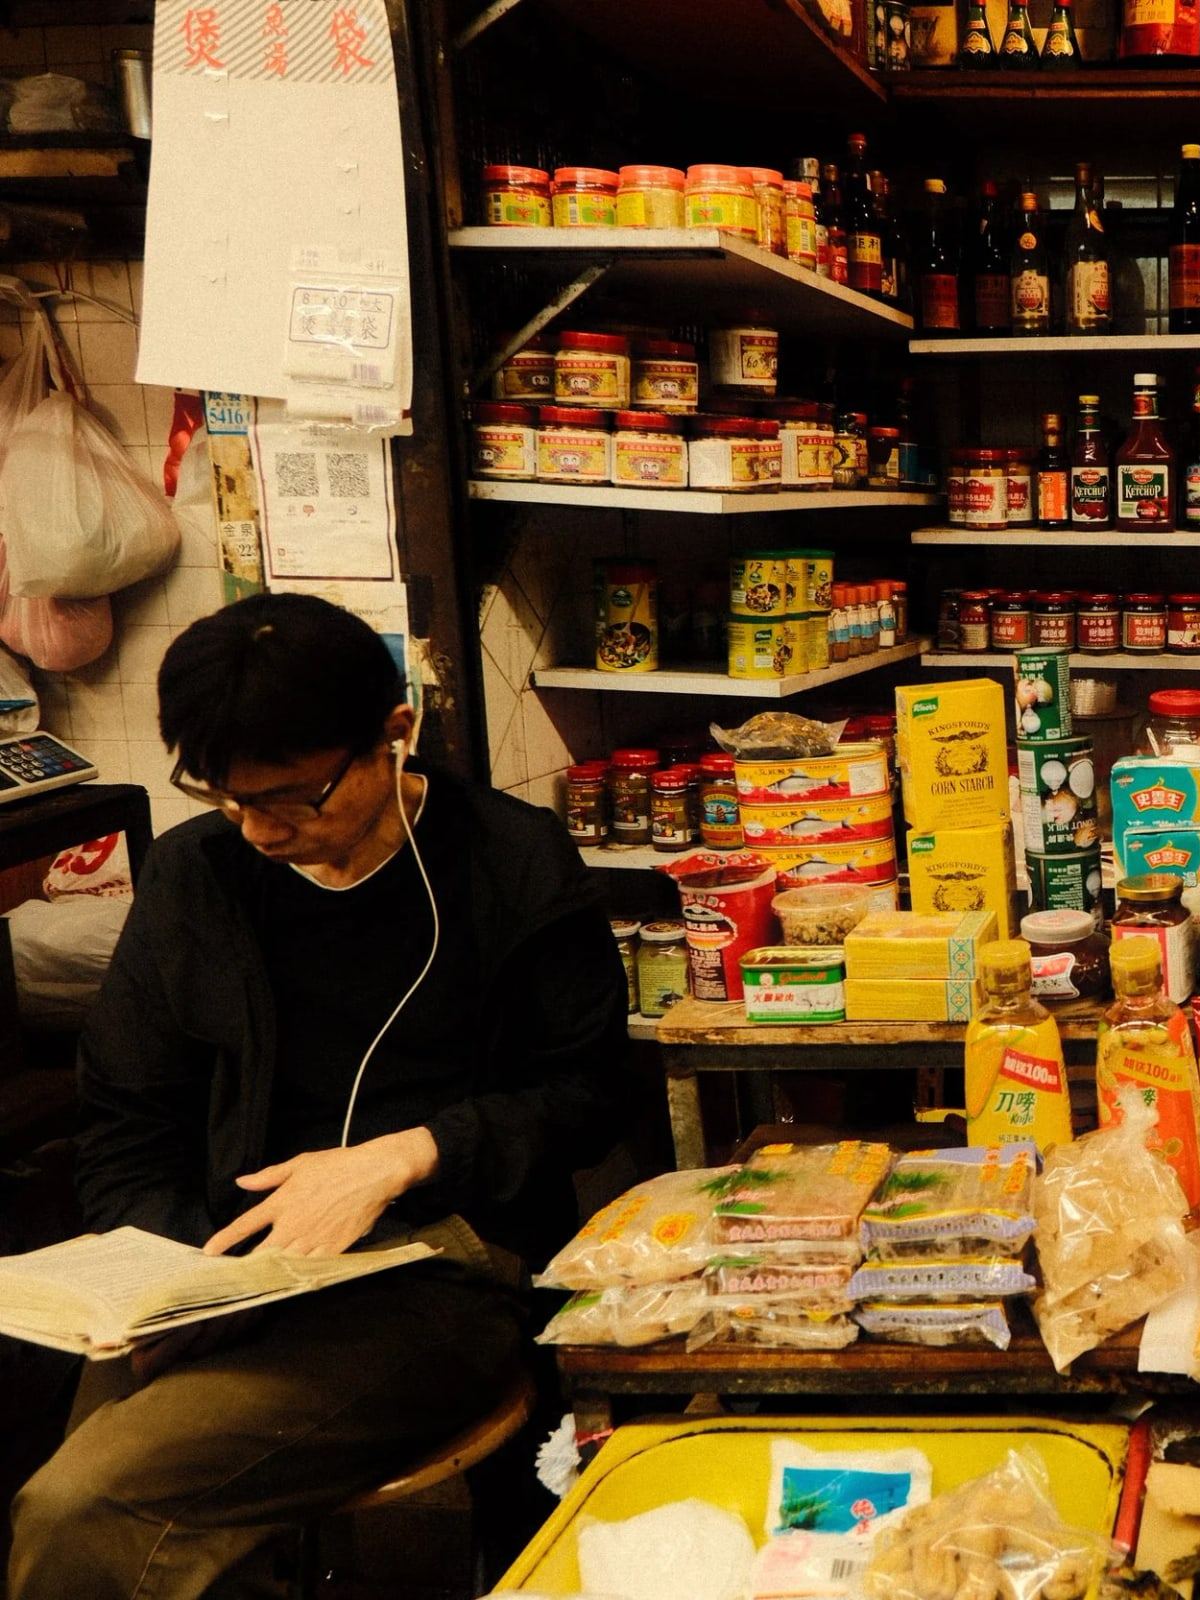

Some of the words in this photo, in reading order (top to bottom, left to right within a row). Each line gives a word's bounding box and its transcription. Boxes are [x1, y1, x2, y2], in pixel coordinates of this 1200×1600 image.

[1074, 485, 1107, 497] KETCHUP
[1125, 484, 1162, 498] KETCHUP
[927, 721, 991, 737] KINGSFORD'S
[930, 779, 959, 796] CORN
[960, 775, 995, 793] STARCH
[925, 861, 990, 873] KINGSFORD'S
